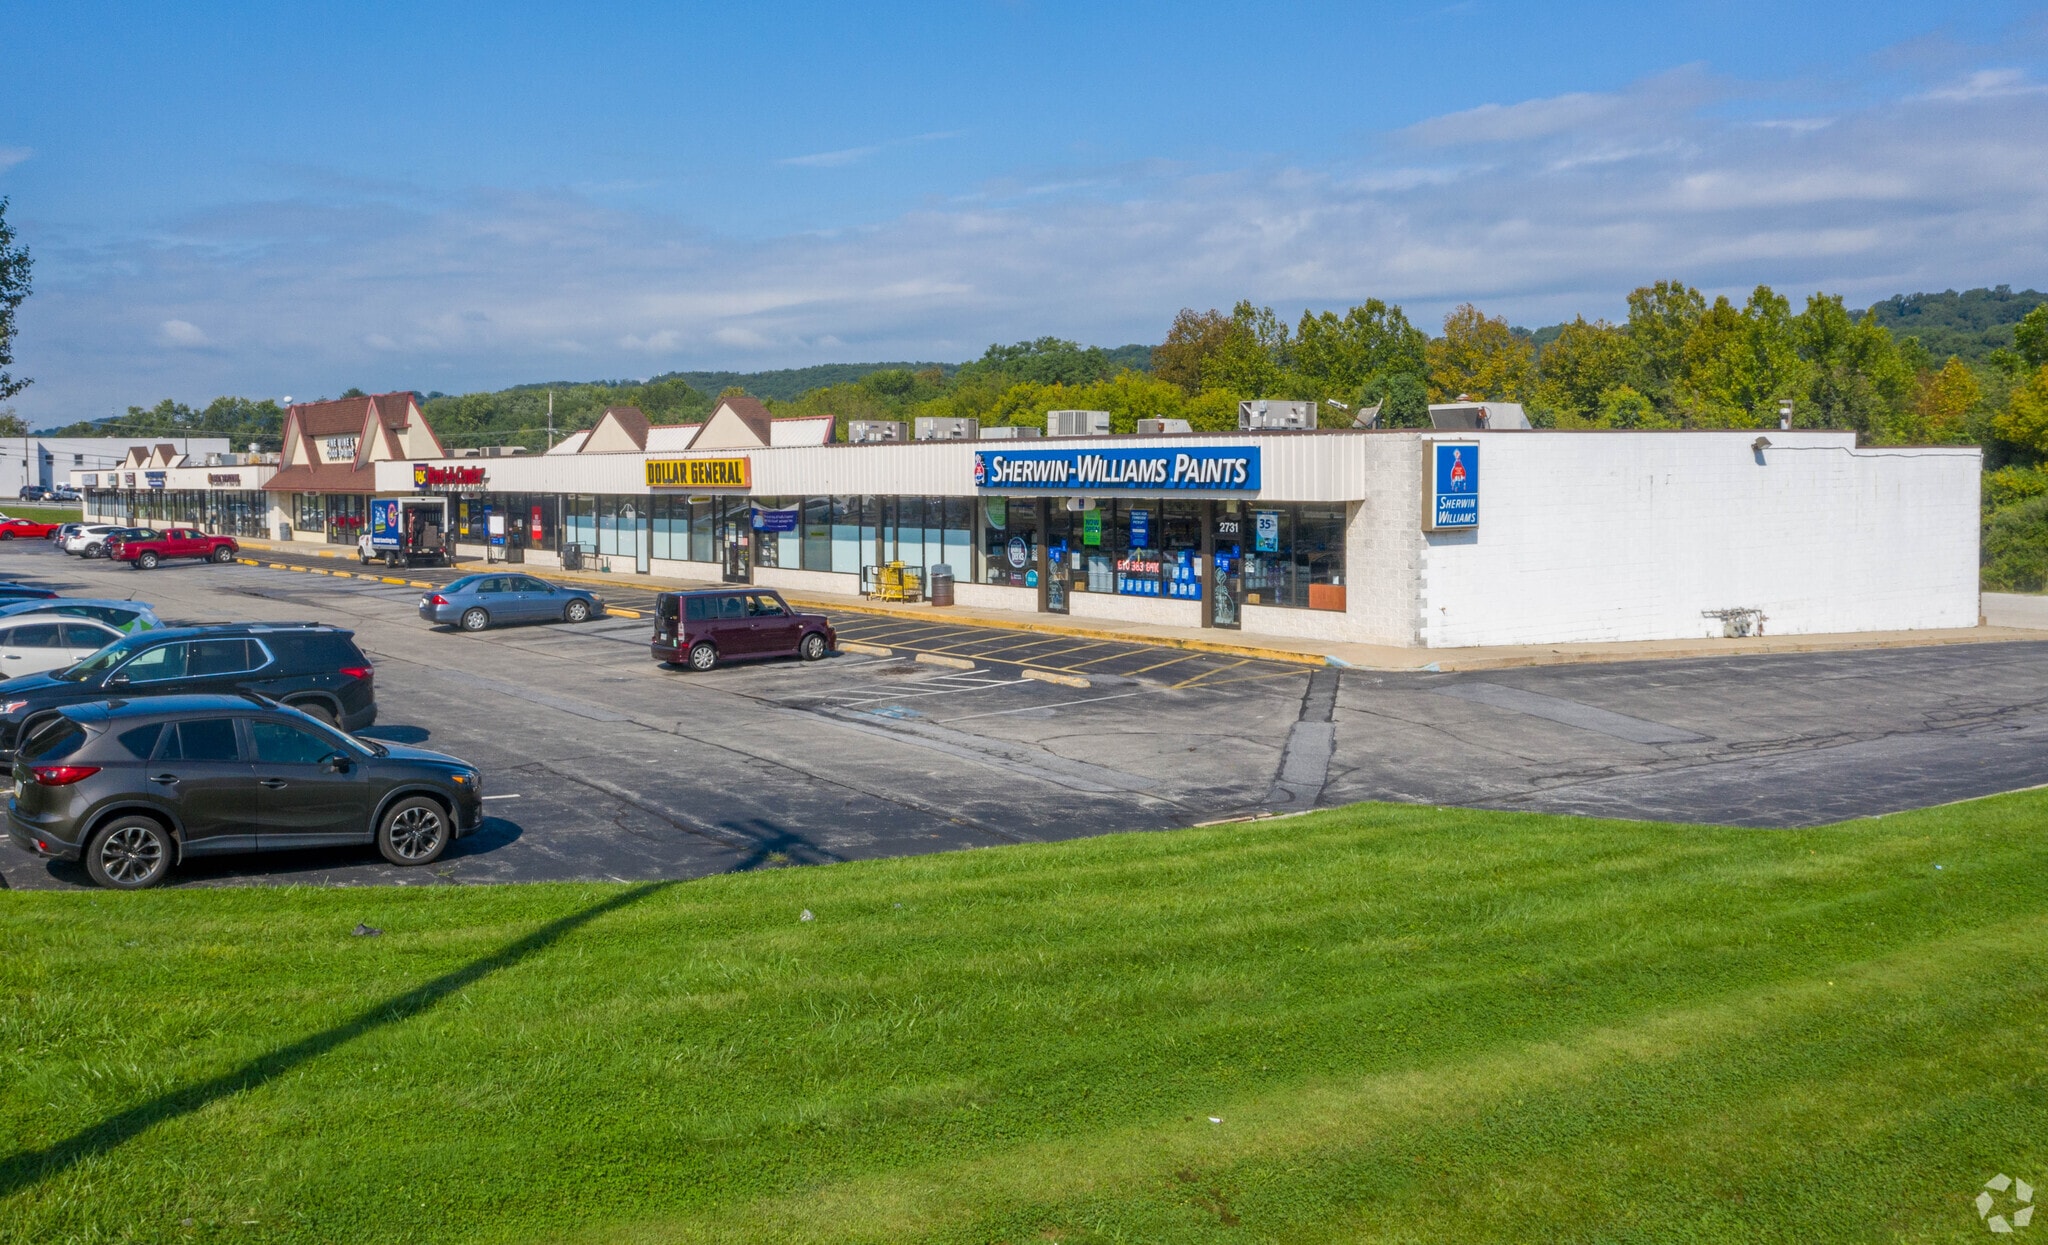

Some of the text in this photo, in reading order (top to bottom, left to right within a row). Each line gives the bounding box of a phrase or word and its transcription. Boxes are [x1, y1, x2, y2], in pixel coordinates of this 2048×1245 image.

[647, 461, 742, 484] DOLLAR GENERAL
[1173, 453, 1248, 484] PAINTS
[1440, 496, 1476, 510] SHERWIN
[1438, 511, 1476, 524] WILLIAMS
[1219, 522, 1239, 533] 2731
